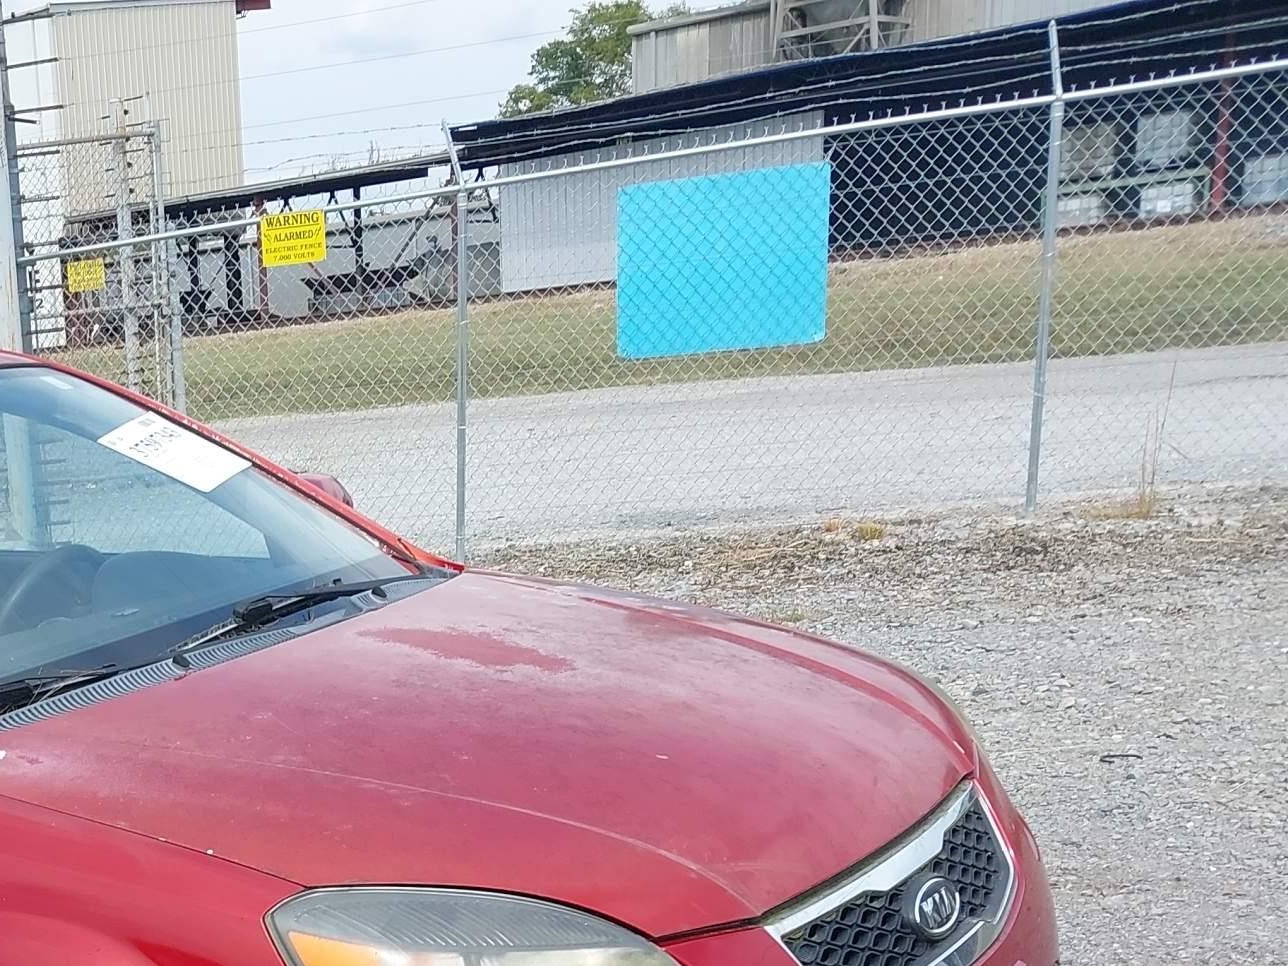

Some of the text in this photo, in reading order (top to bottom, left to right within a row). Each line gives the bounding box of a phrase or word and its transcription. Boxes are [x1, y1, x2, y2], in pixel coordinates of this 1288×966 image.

[266, 213, 318, 228] WARNING
[273, 230, 314, 243] ALARMED
[265, 242, 323, 254] ELECTRIC FENCE
[293, 251, 315, 260] VOLTS
[920, 886, 957, 929] KIA
